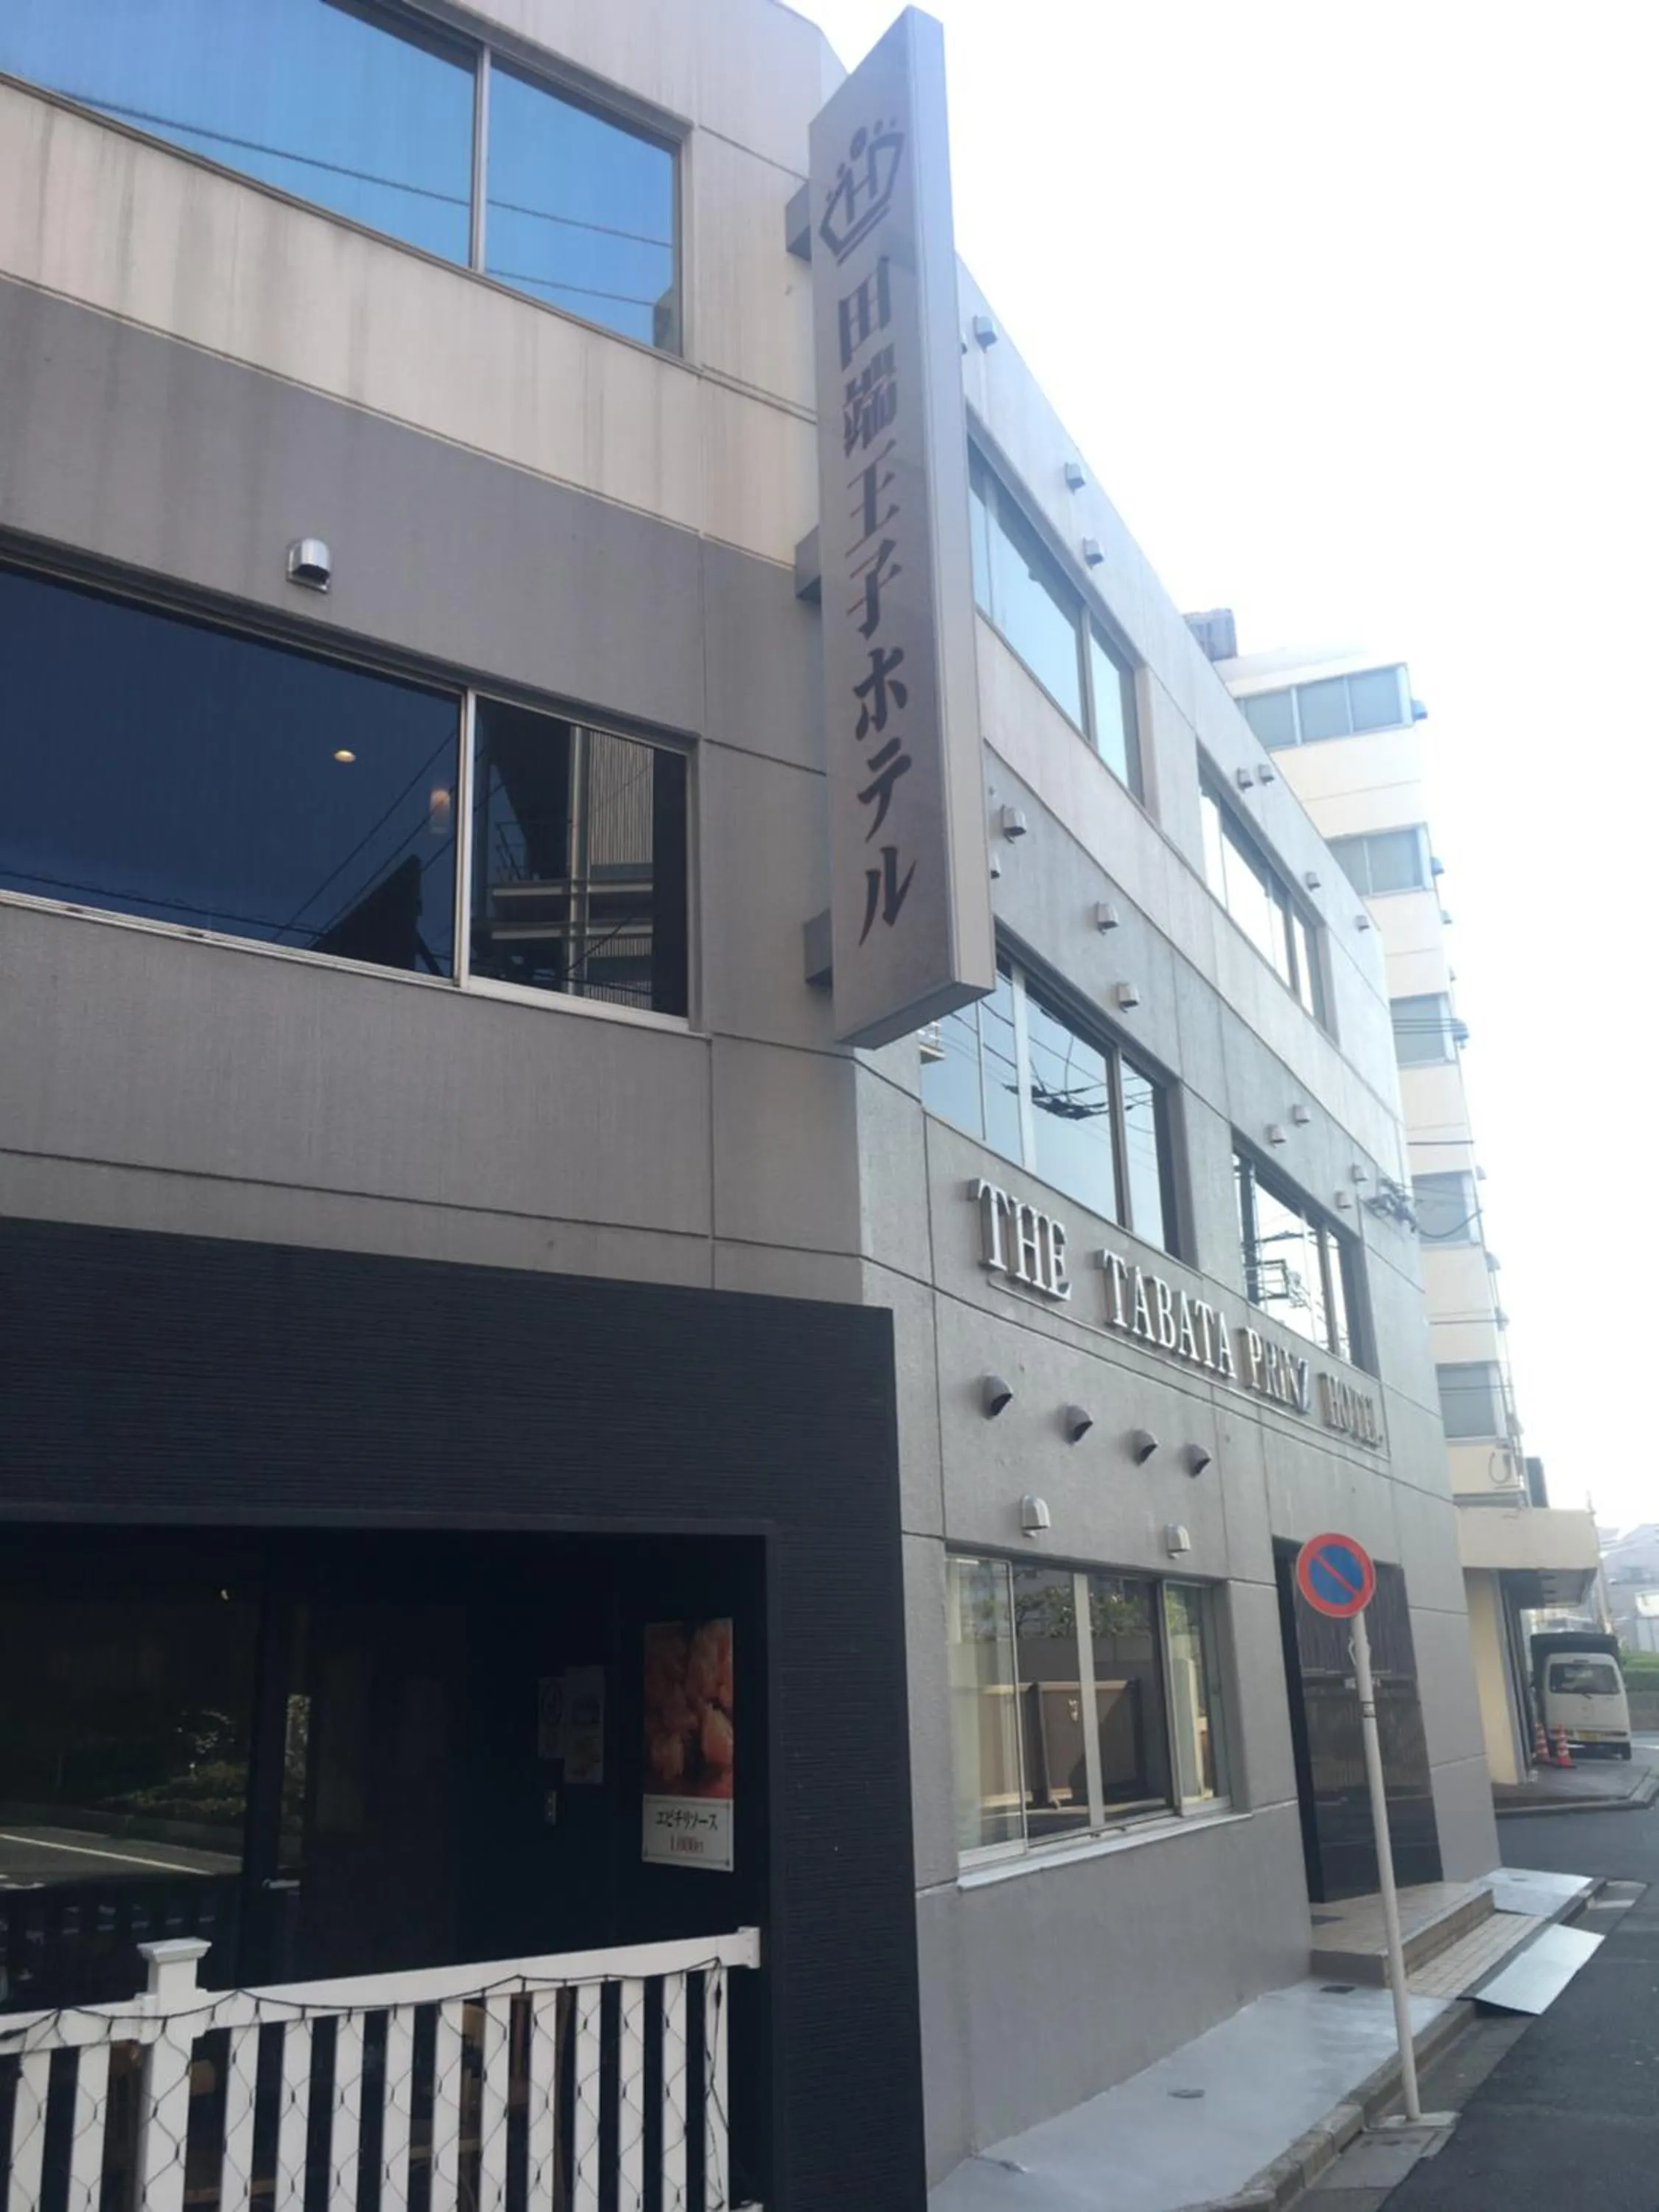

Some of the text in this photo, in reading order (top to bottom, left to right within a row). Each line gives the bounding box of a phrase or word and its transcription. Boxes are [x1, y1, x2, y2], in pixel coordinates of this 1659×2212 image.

[838, 255, 918, 947] 田端王子ホテル
[969, 1177, 1073, 1301] THE
[1096, 1248, 1238, 1381] TABATA
[1240, 1326, 1312, 1415] PRINZ
[655, 1808, 719, 1832] エビチリソース
